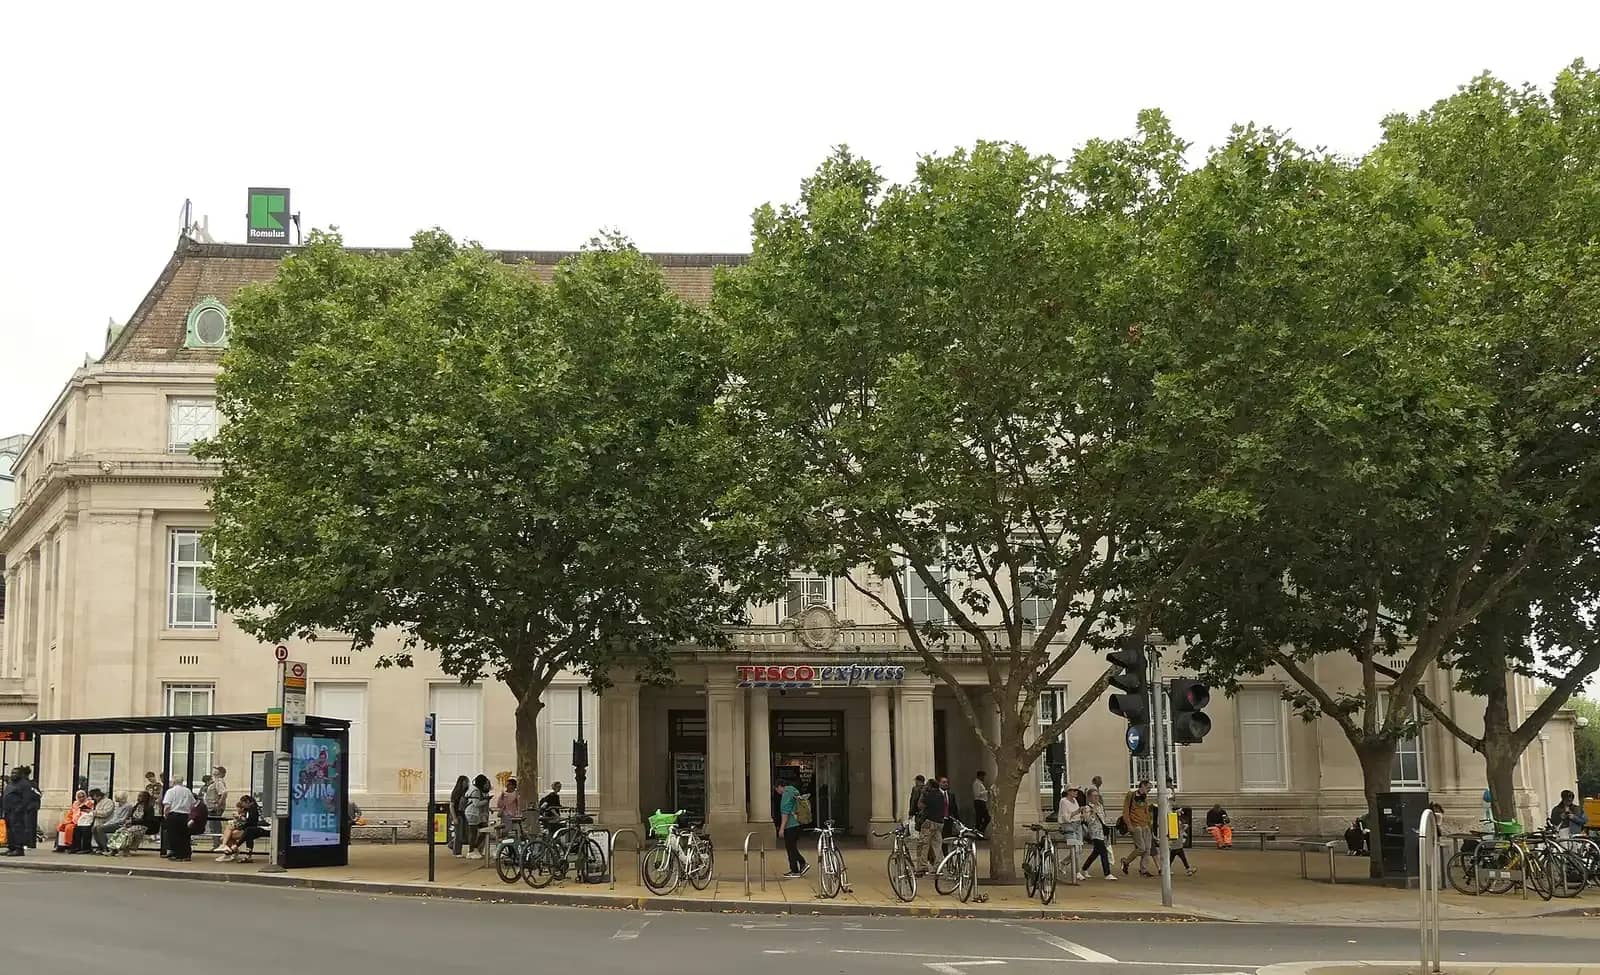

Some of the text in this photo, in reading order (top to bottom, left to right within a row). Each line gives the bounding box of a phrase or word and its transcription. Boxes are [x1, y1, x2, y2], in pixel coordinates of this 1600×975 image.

[250, 229, 285, 237] Romulus
[278, 648, 286, 658] D
[738, 663, 906, 686] TESCO express
[296, 743, 329, 761] KIDS
[294, 783, 335, 800] SWIM
[301, 813, 336, 828] FREE
